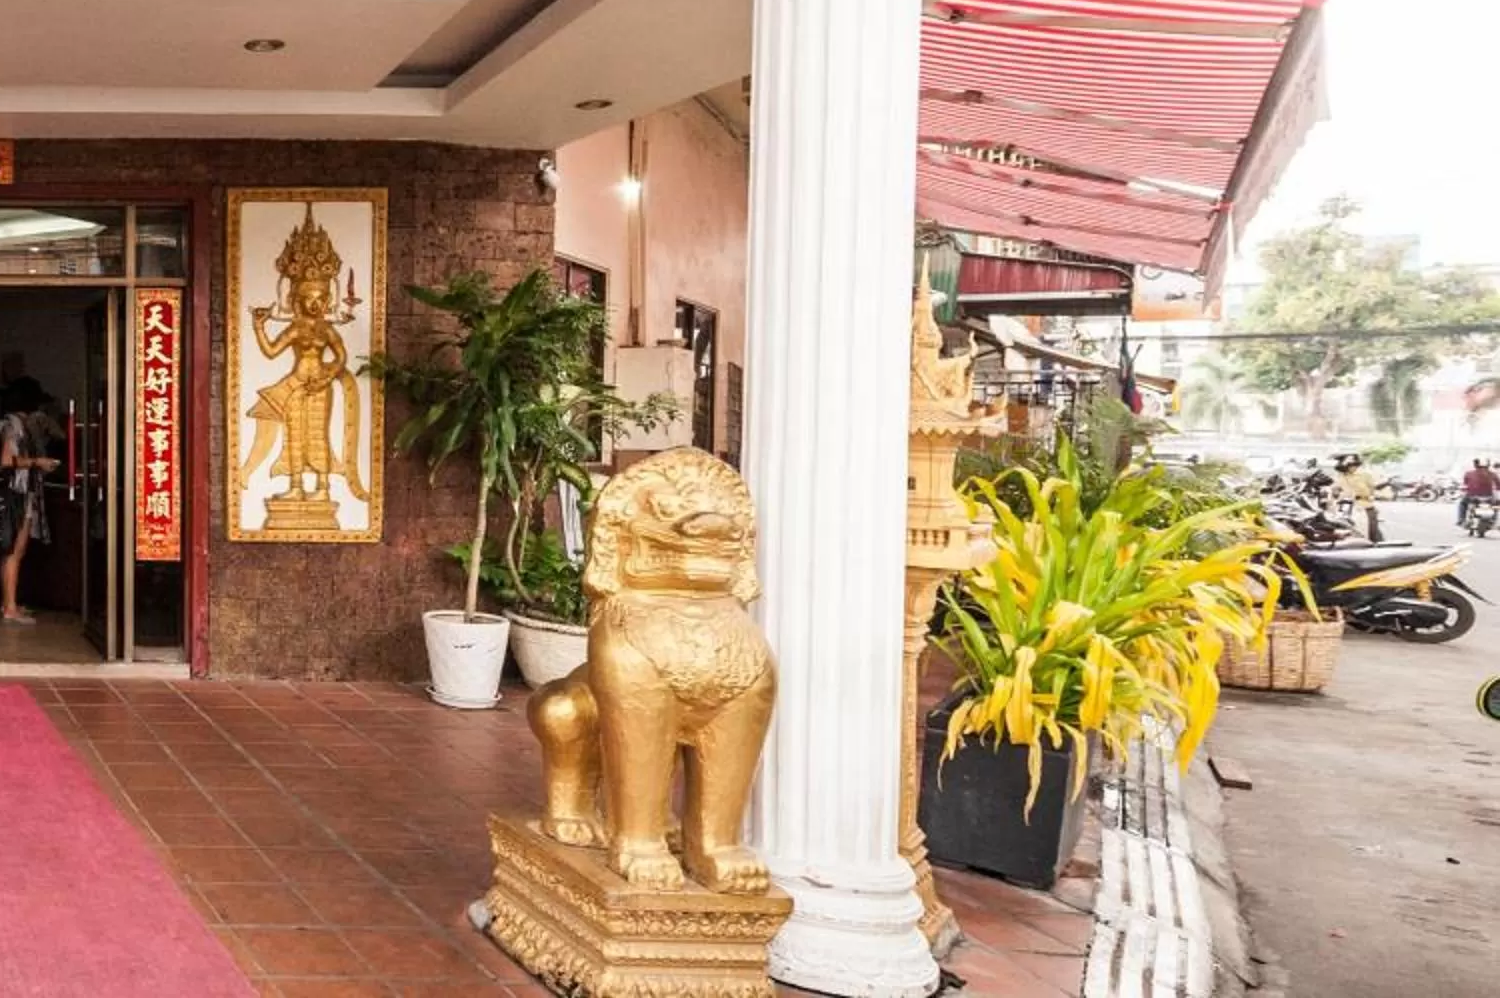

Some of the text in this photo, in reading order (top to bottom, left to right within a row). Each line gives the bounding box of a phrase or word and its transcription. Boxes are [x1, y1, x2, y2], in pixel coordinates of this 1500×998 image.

[143, 304, 173, 520] 天天好運事事順
